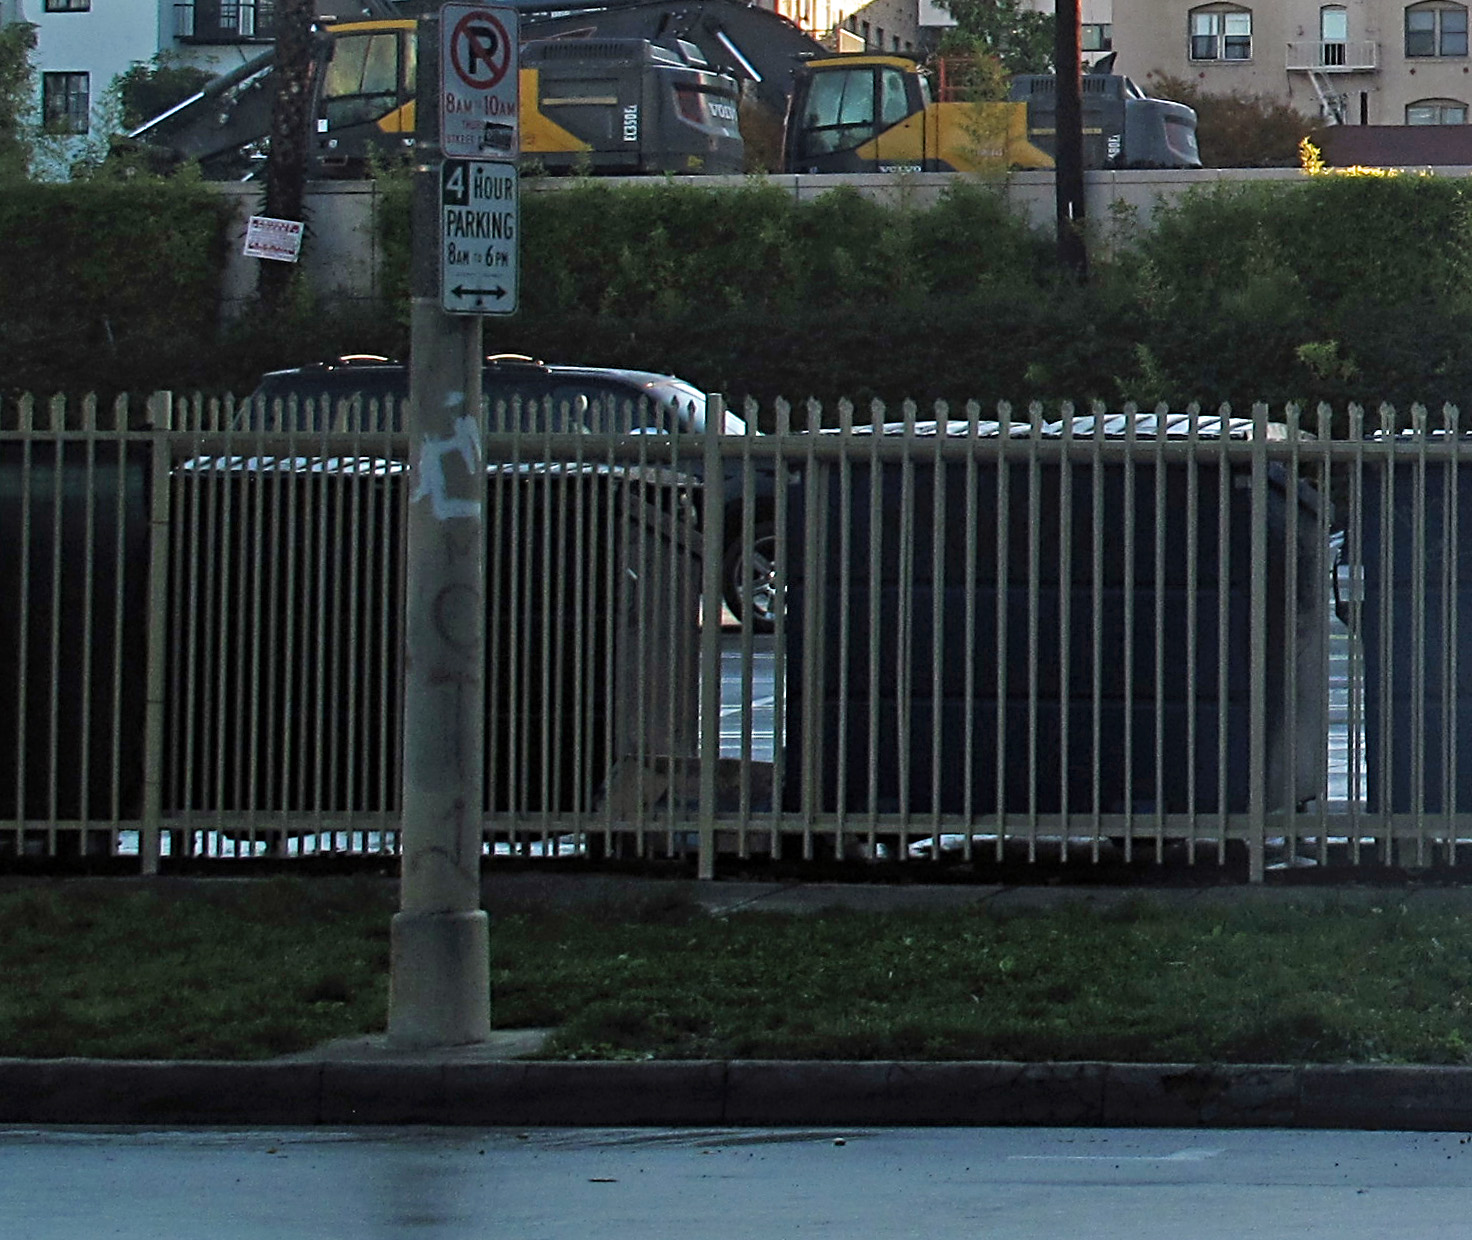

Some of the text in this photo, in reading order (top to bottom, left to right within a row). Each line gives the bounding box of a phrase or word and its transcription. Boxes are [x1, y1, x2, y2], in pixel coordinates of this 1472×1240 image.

[446, 93, 472, 113] 8AM
[484, 95, 515, 115] 10AM
[446, 166, 513, 200] 4 HOUR
[447, 209, 514, 240] PARKING
[449, 242, 469, 265] 8AM
[486, 245, 508, 267] 6PM
